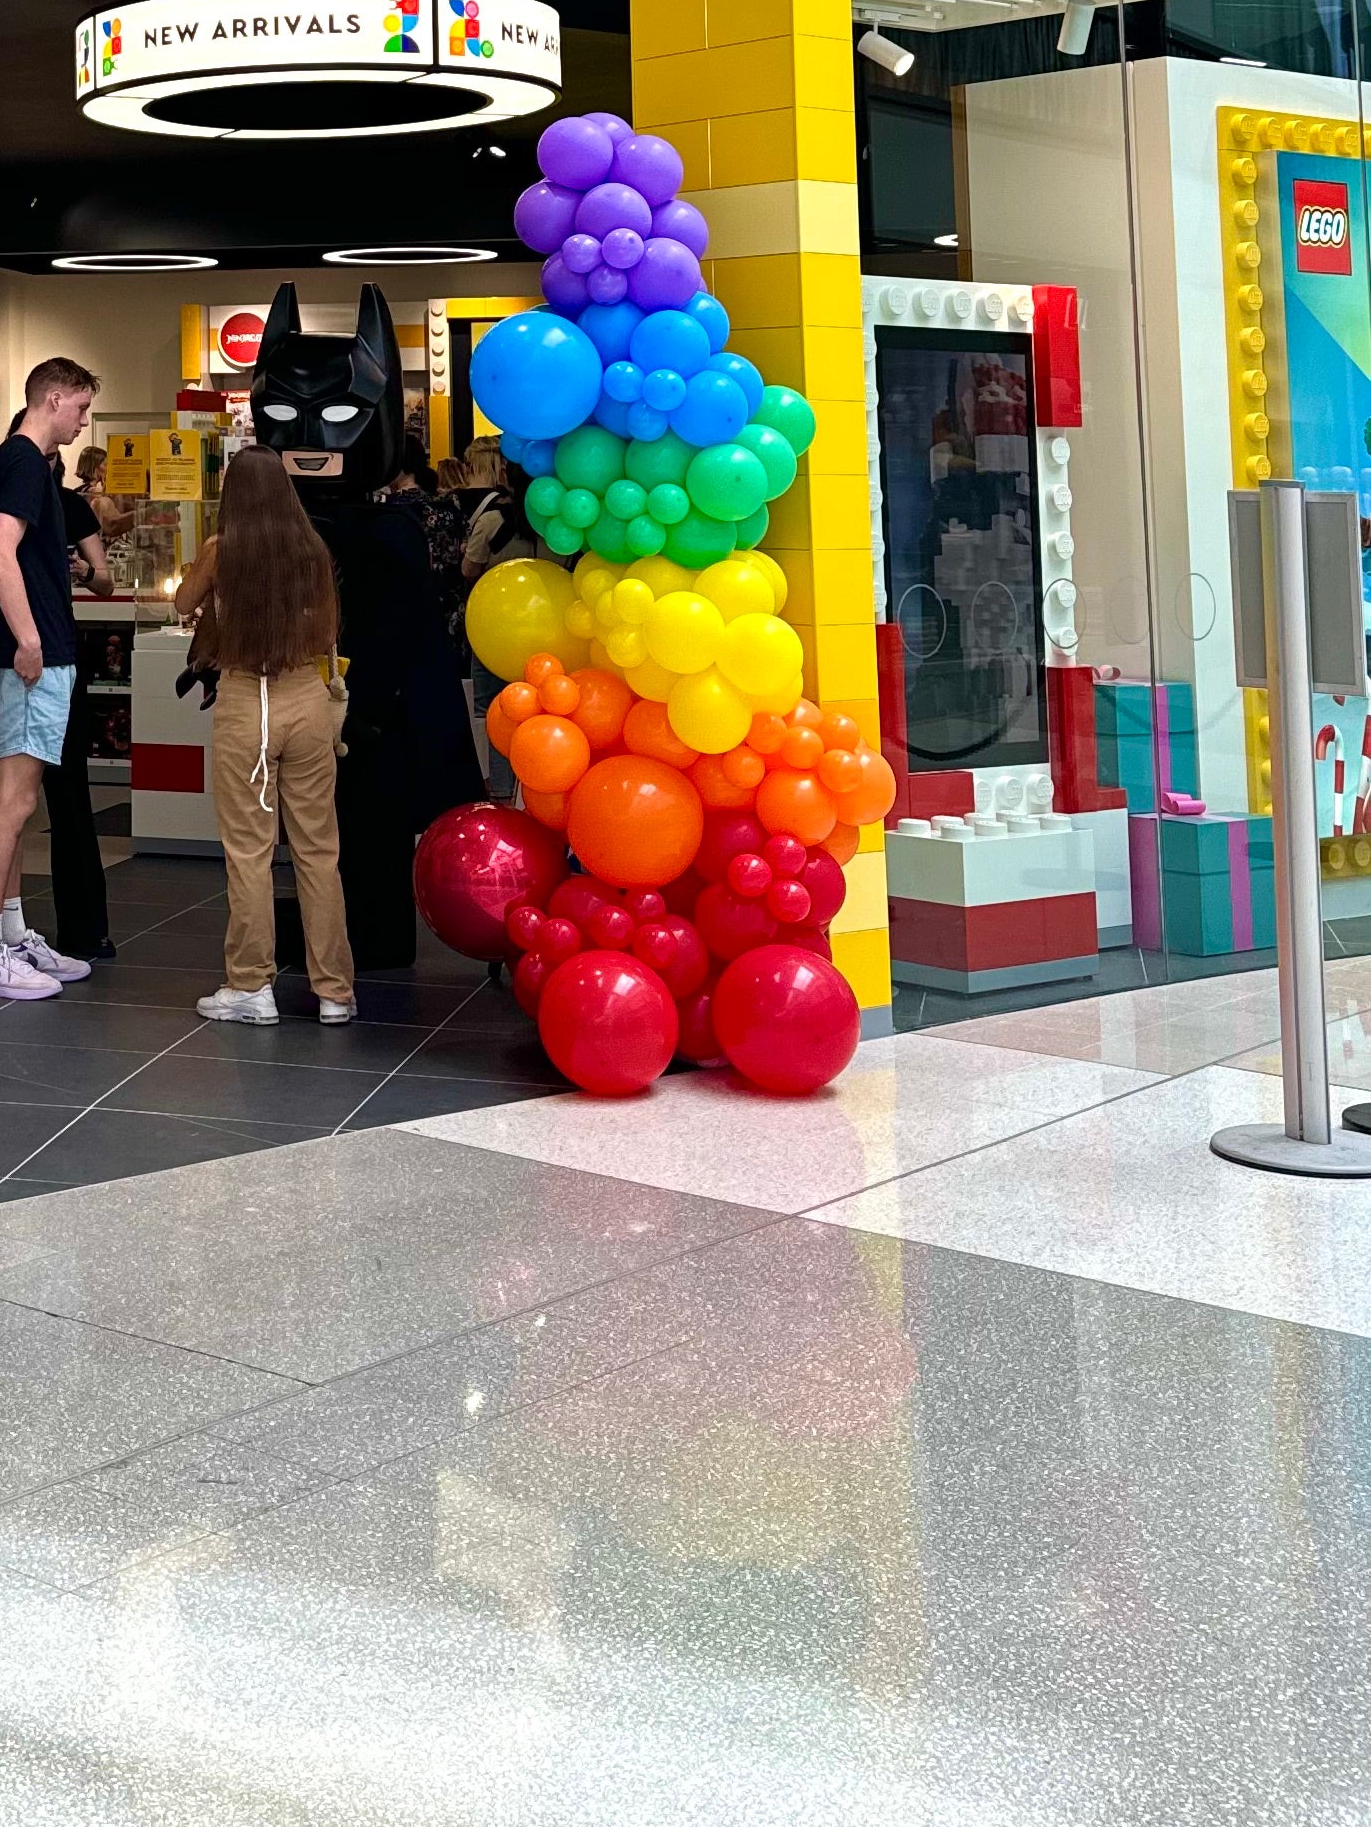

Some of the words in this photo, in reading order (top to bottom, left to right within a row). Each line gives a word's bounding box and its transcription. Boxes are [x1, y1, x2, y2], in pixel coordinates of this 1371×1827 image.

[145, 22, 199, 49] NEW
[212, 14, 361, 40] ARRIVALS
[502, 21, 539, 48] NEW
[1299, 207, 1346, 246] LEGO
